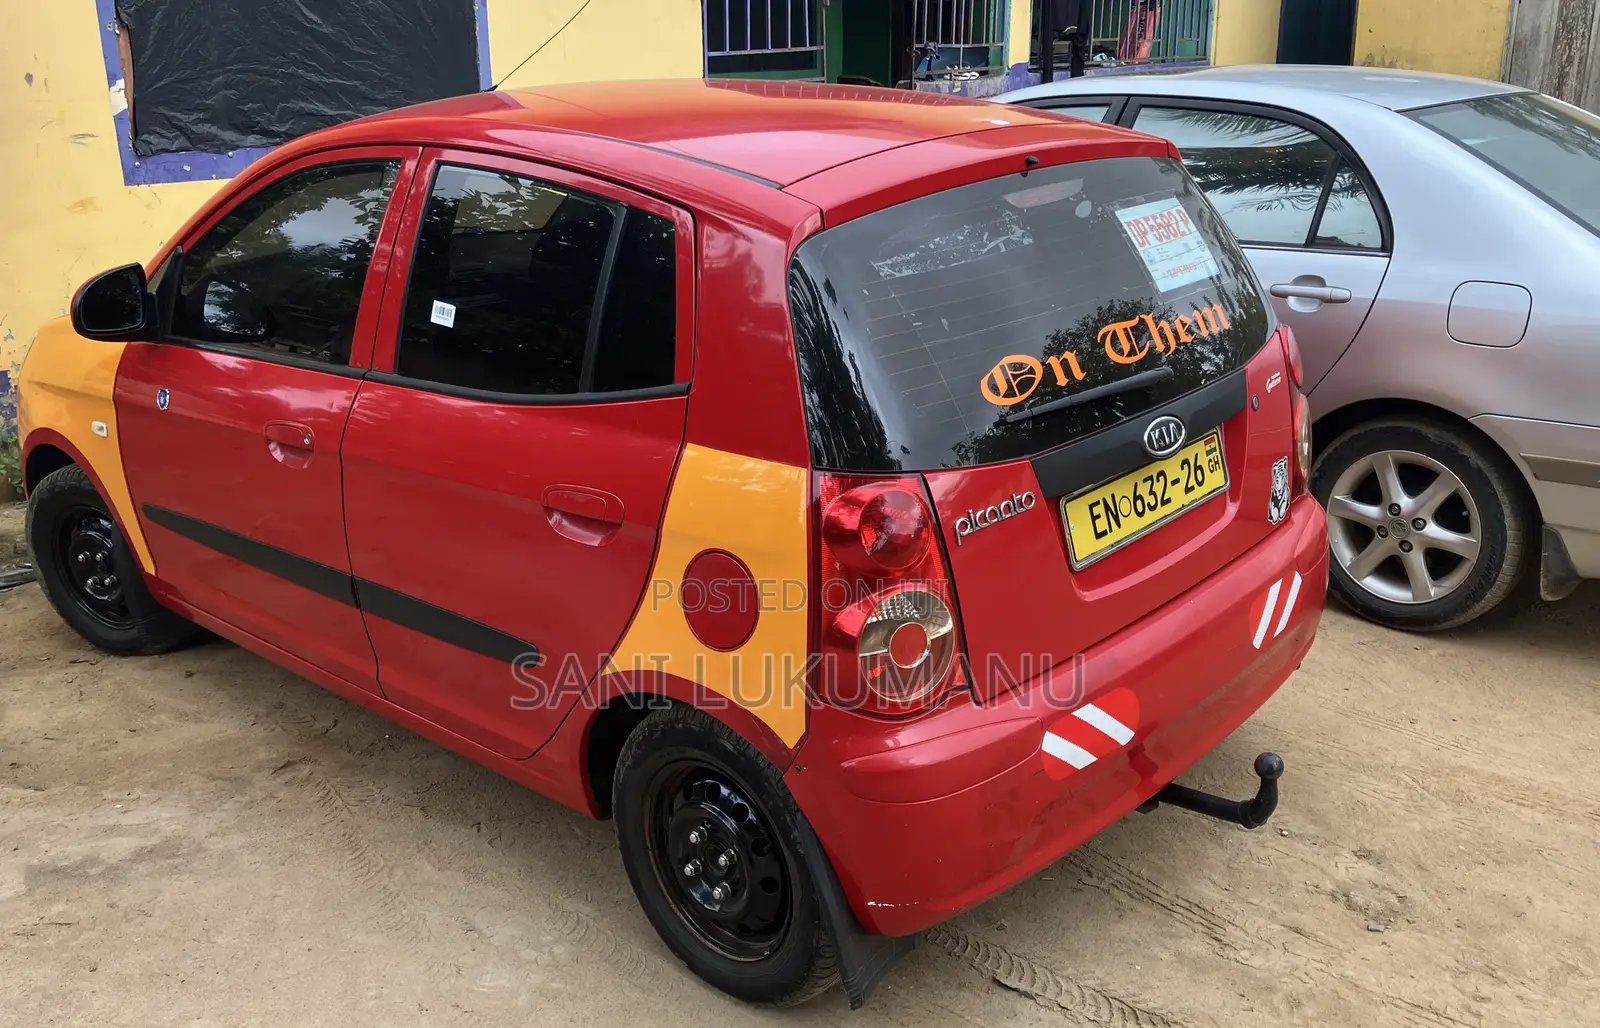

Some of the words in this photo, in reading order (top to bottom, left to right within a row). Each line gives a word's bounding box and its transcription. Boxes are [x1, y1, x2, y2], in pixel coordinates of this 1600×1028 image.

[980, 348, 1087, 406] On
[1097, 302, 1231, 365] Them
[1149, 421, 1183, 451] KIA
[1131, 452, 1206, 520] 632-26
[1207, 456, 1222, 475] GH
[953, 490, 1036, 546] picanto
